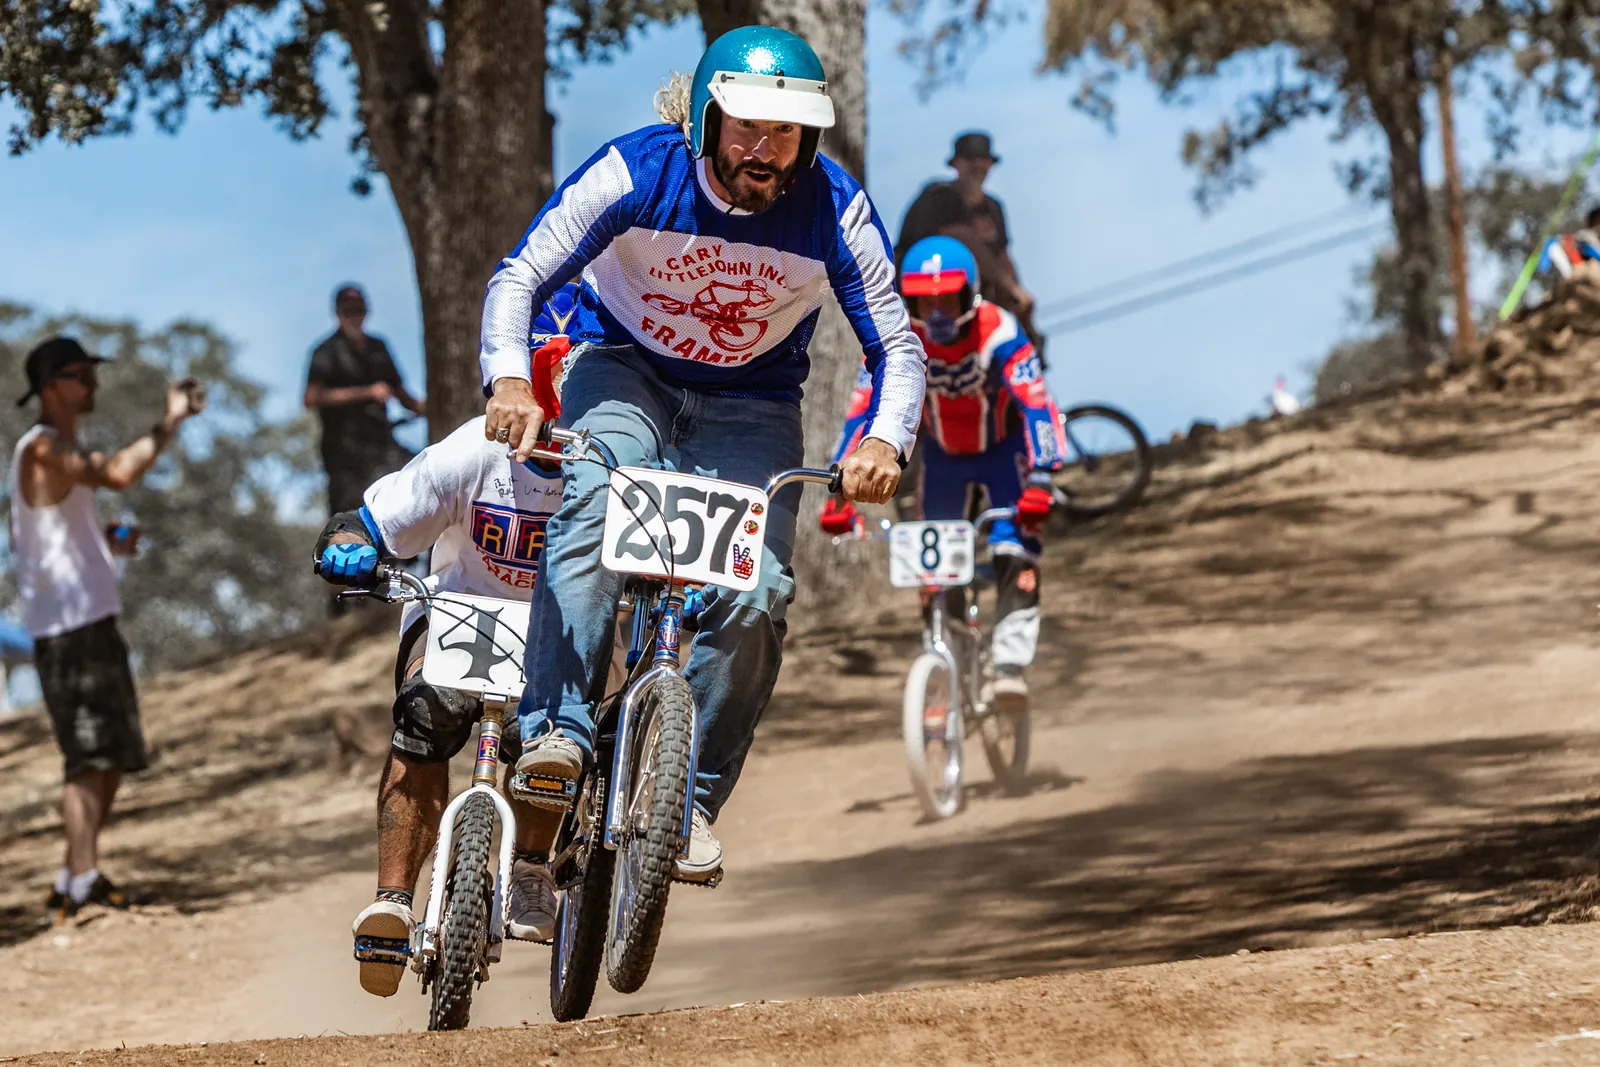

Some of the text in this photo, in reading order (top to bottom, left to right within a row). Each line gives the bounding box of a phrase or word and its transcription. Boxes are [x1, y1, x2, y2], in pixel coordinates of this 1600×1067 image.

[649, 259, 751, 283] LITTLEJOHN
[666, 244, 722, 270] CARY
[614, 479, 750, 575] 257
[921, 527, 941, 571] 8
[437, 603, 515, 685] 4
